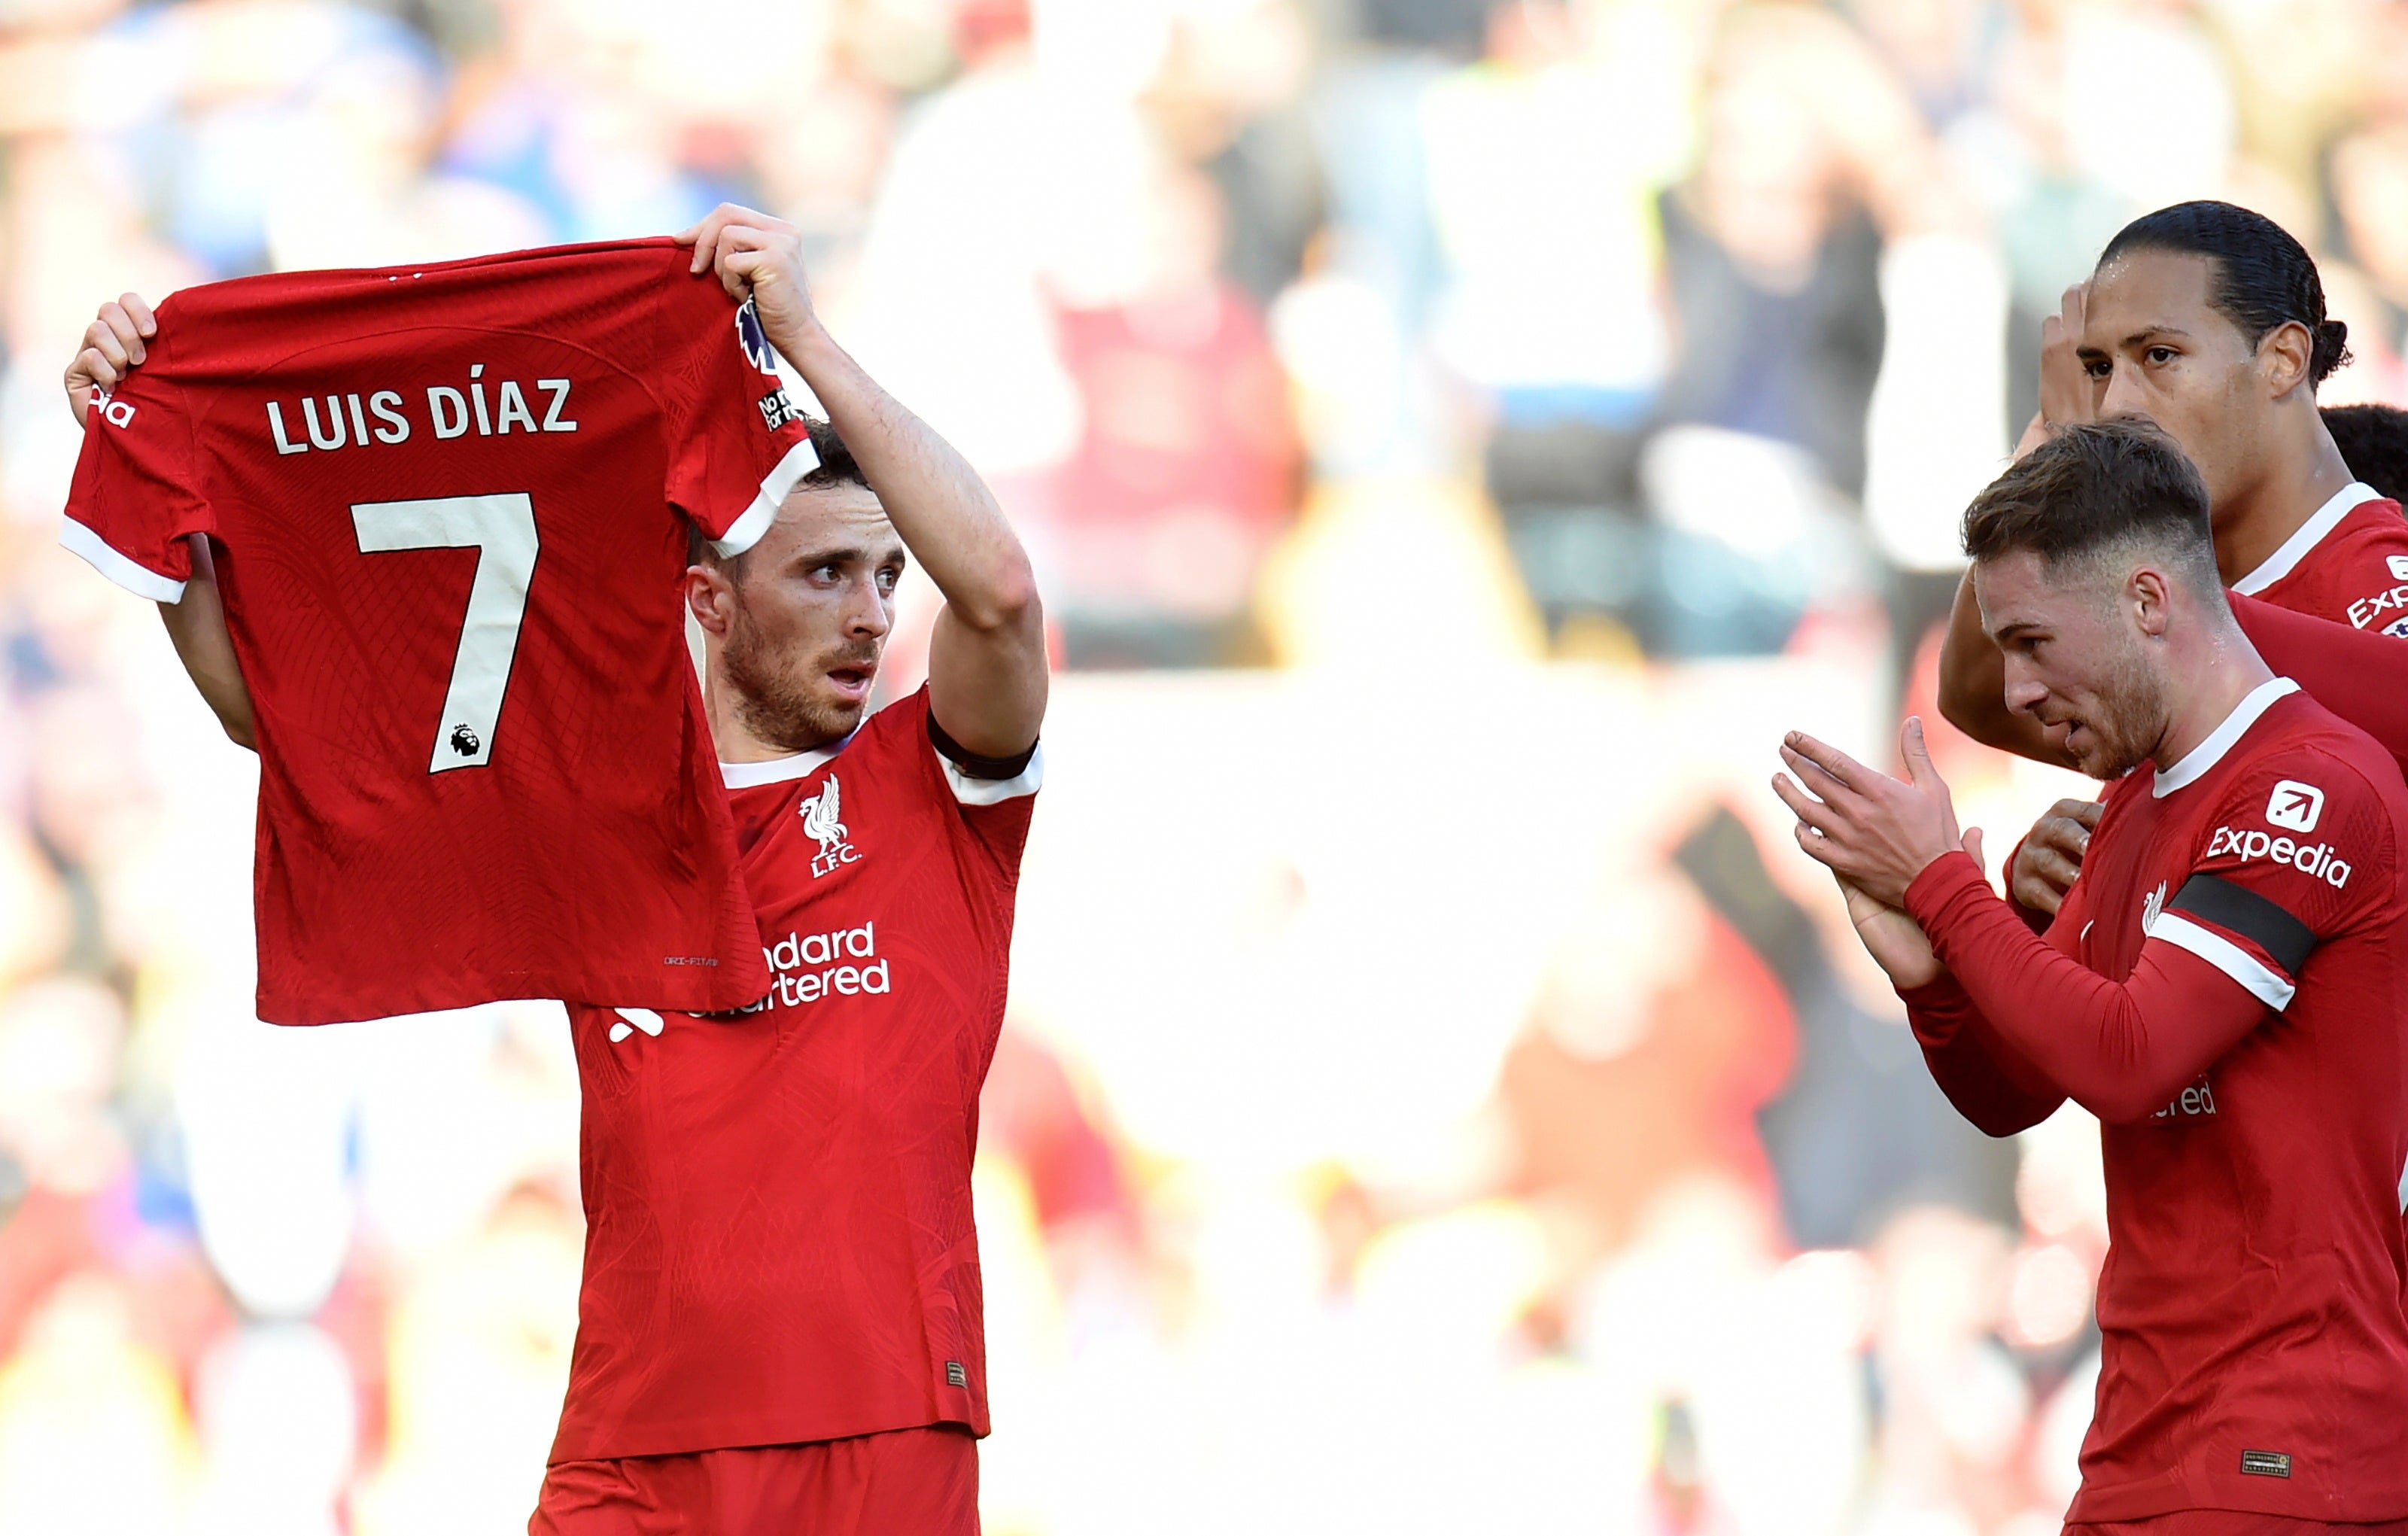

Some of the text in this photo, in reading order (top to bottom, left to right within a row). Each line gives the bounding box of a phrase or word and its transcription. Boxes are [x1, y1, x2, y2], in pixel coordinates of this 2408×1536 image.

[266, 363, 578, 455] LUIS DÍAZ
[758, 396, 777, 418] No
[349, 491, 540, 776] 7
[2346, 585, 2408, 629] Exp
[2206, 826, 2352, 890] Expedia
